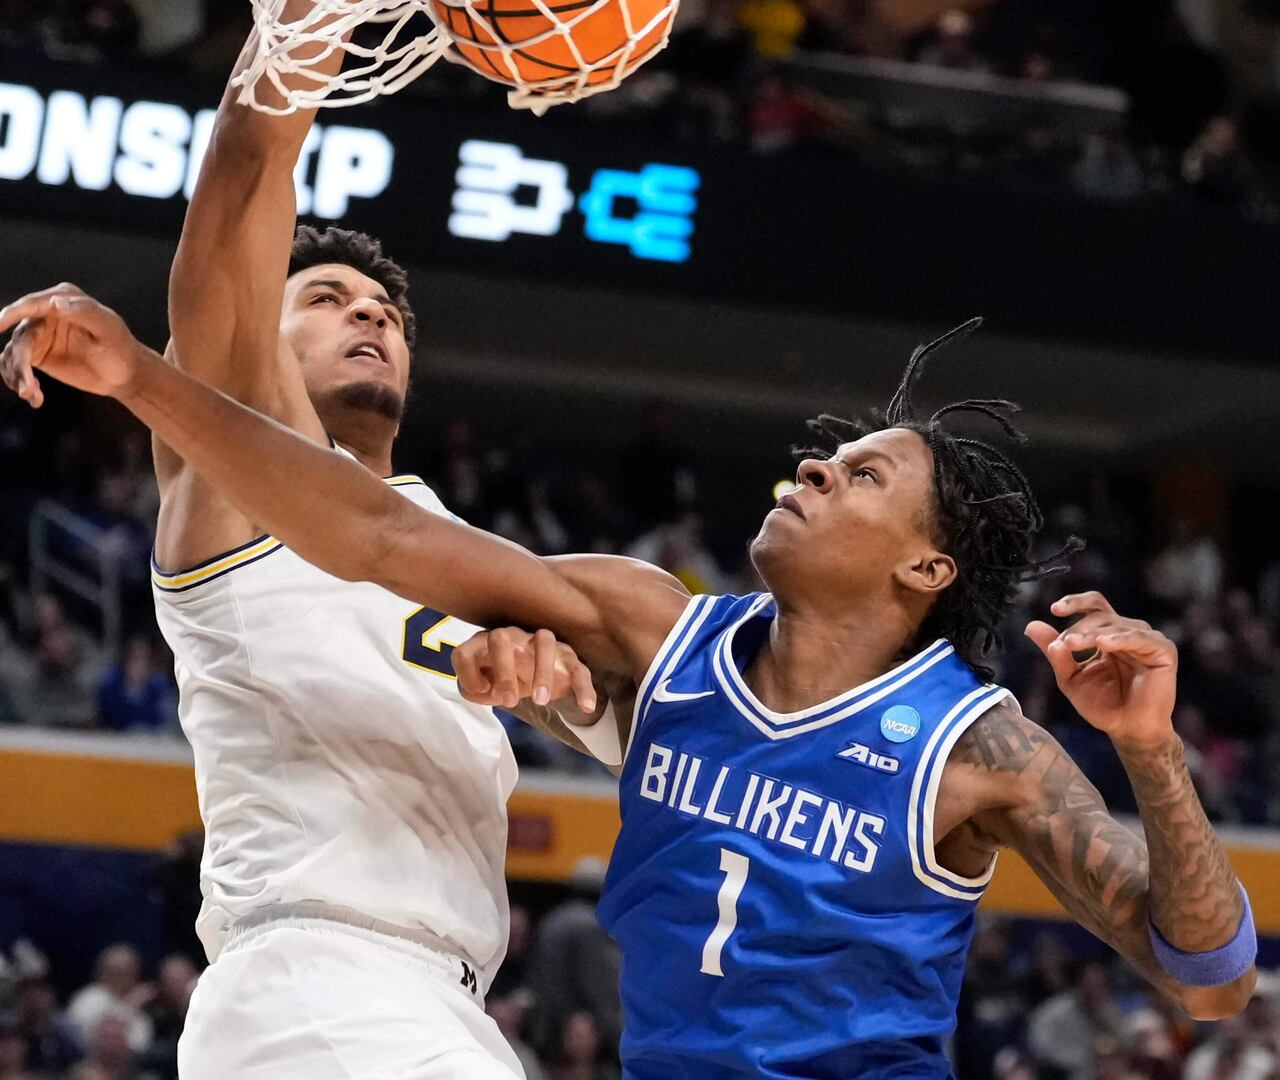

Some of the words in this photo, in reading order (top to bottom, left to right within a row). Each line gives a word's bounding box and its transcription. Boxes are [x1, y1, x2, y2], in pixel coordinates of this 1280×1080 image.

[883, 719, 917, 737] NCAA
[639, 742, 888, 873] BILLIKENS
[699, 848, 751, 978] 1
